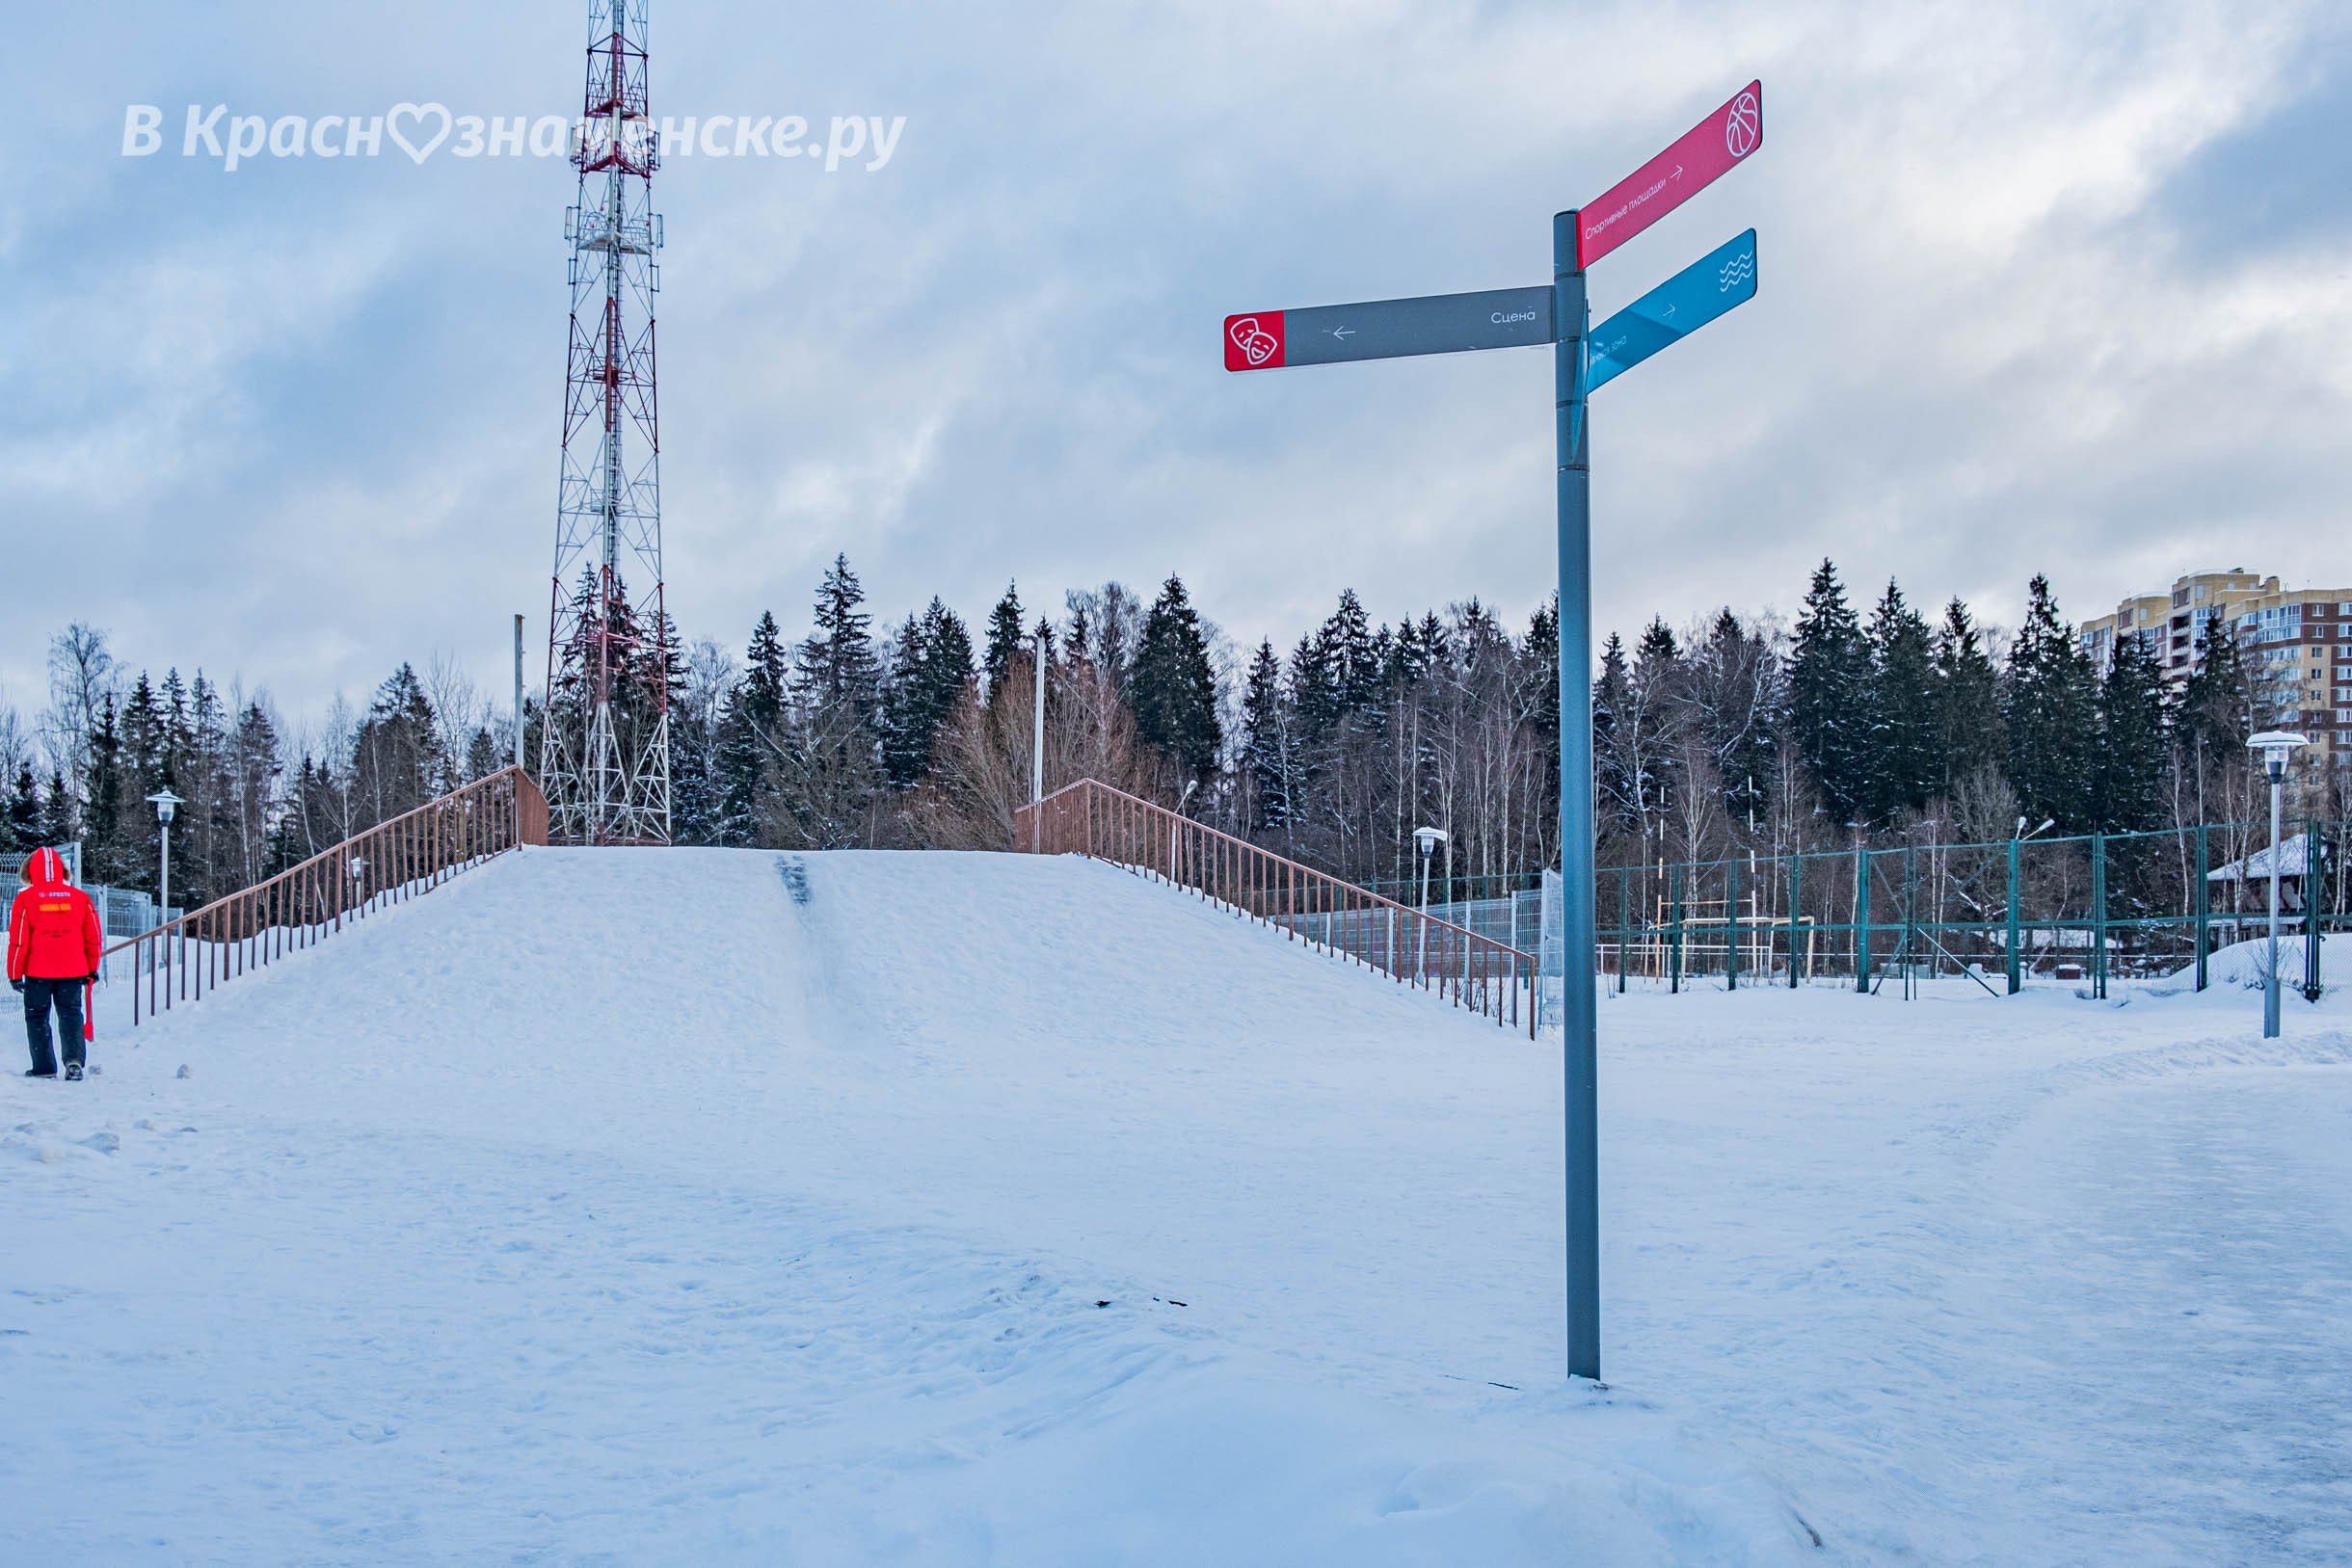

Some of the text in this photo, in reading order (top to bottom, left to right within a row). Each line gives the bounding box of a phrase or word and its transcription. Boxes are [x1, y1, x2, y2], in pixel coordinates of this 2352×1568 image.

[1585, 178, 1667, 240] Спортивные площадки
[1490, 311, 1536, 324] Сцена
